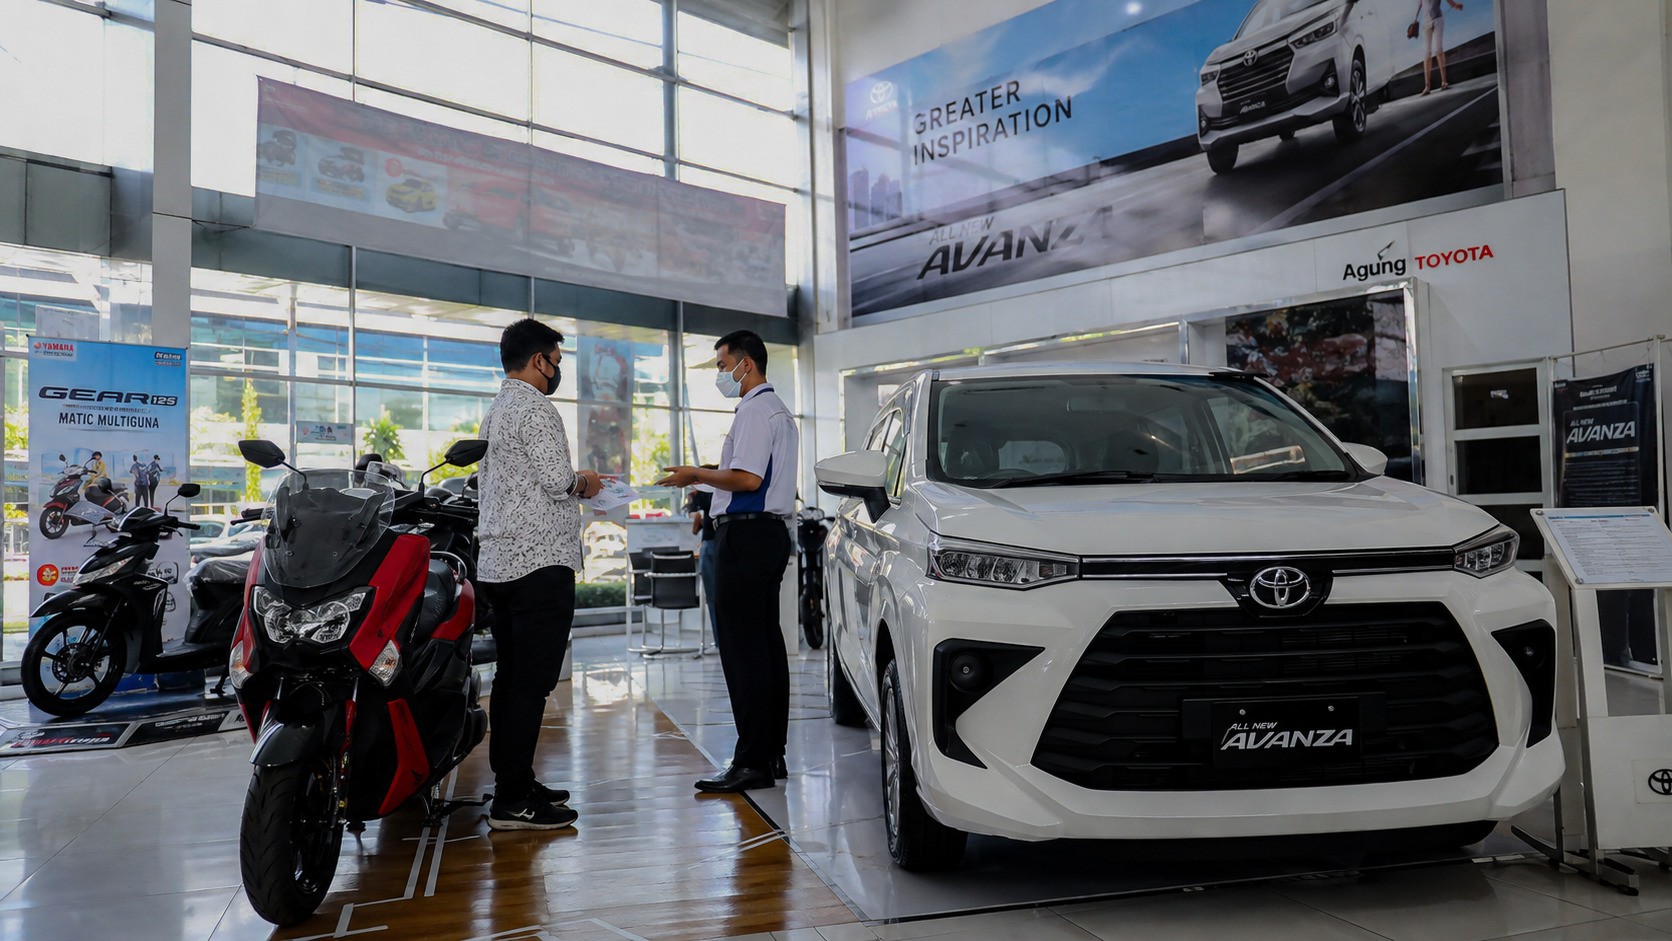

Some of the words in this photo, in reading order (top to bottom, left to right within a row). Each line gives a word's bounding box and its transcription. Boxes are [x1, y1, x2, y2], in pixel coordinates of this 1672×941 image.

[913, 80, 1021, 135] GREATER
[912, 95, 1073, 165] INSPIRATION
[929, 225, 955, 245] ALL
[960, 216, 995, 237] NEW
[1342, 257, 1407, 281] Agung
[1414, 244, 1494, 271] TOYOTA
[38, 386, 151, 404] GEAR
[58, 412, 94, 425] MATIC
[97, 413, 160, 429] MULTIGUNA
[1566, 421, 1636, 444] AVANZA
[1252, 722, 1278, 730] NEW
[1220, 729, 1353, 750] AVANZA
